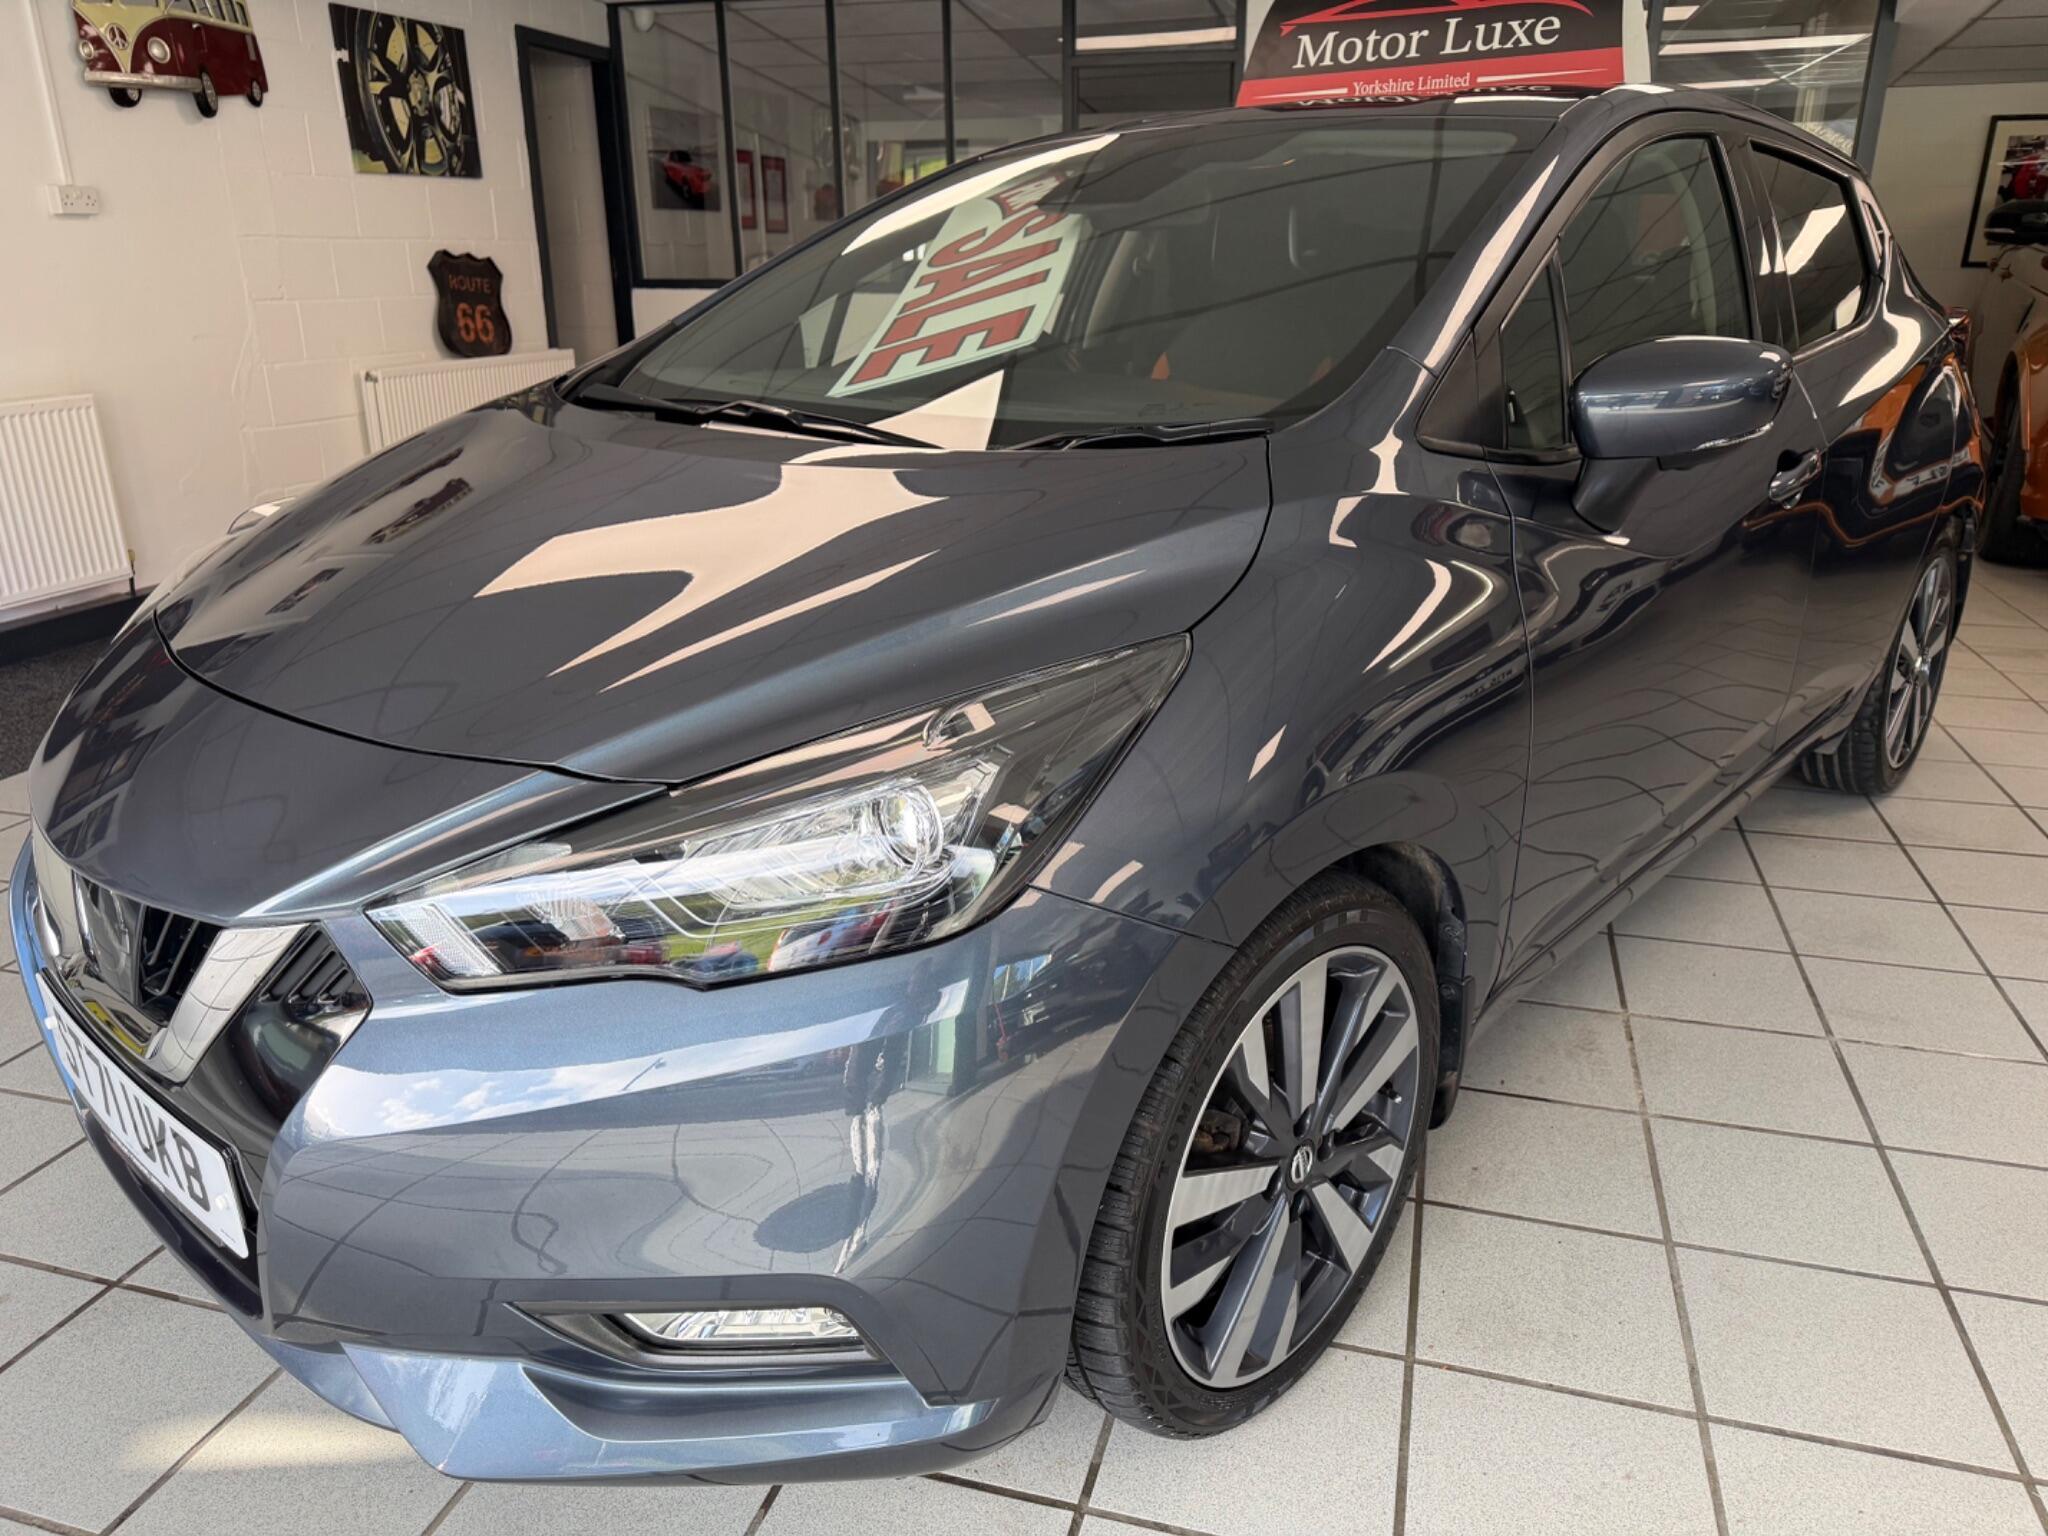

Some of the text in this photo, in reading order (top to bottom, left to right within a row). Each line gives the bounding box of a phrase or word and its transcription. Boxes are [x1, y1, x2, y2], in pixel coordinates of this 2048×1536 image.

[1292, 14, 1561, 70] Motor Luxe
[1352, 73, 1470, 96] Yorkshire Limited
[447, 274, 492, 294] ROUTE
[846, 206, 1068, 386] SALE
[456, 302, 495, 345] 66
[120, 1081, 211, 1213] UKB
